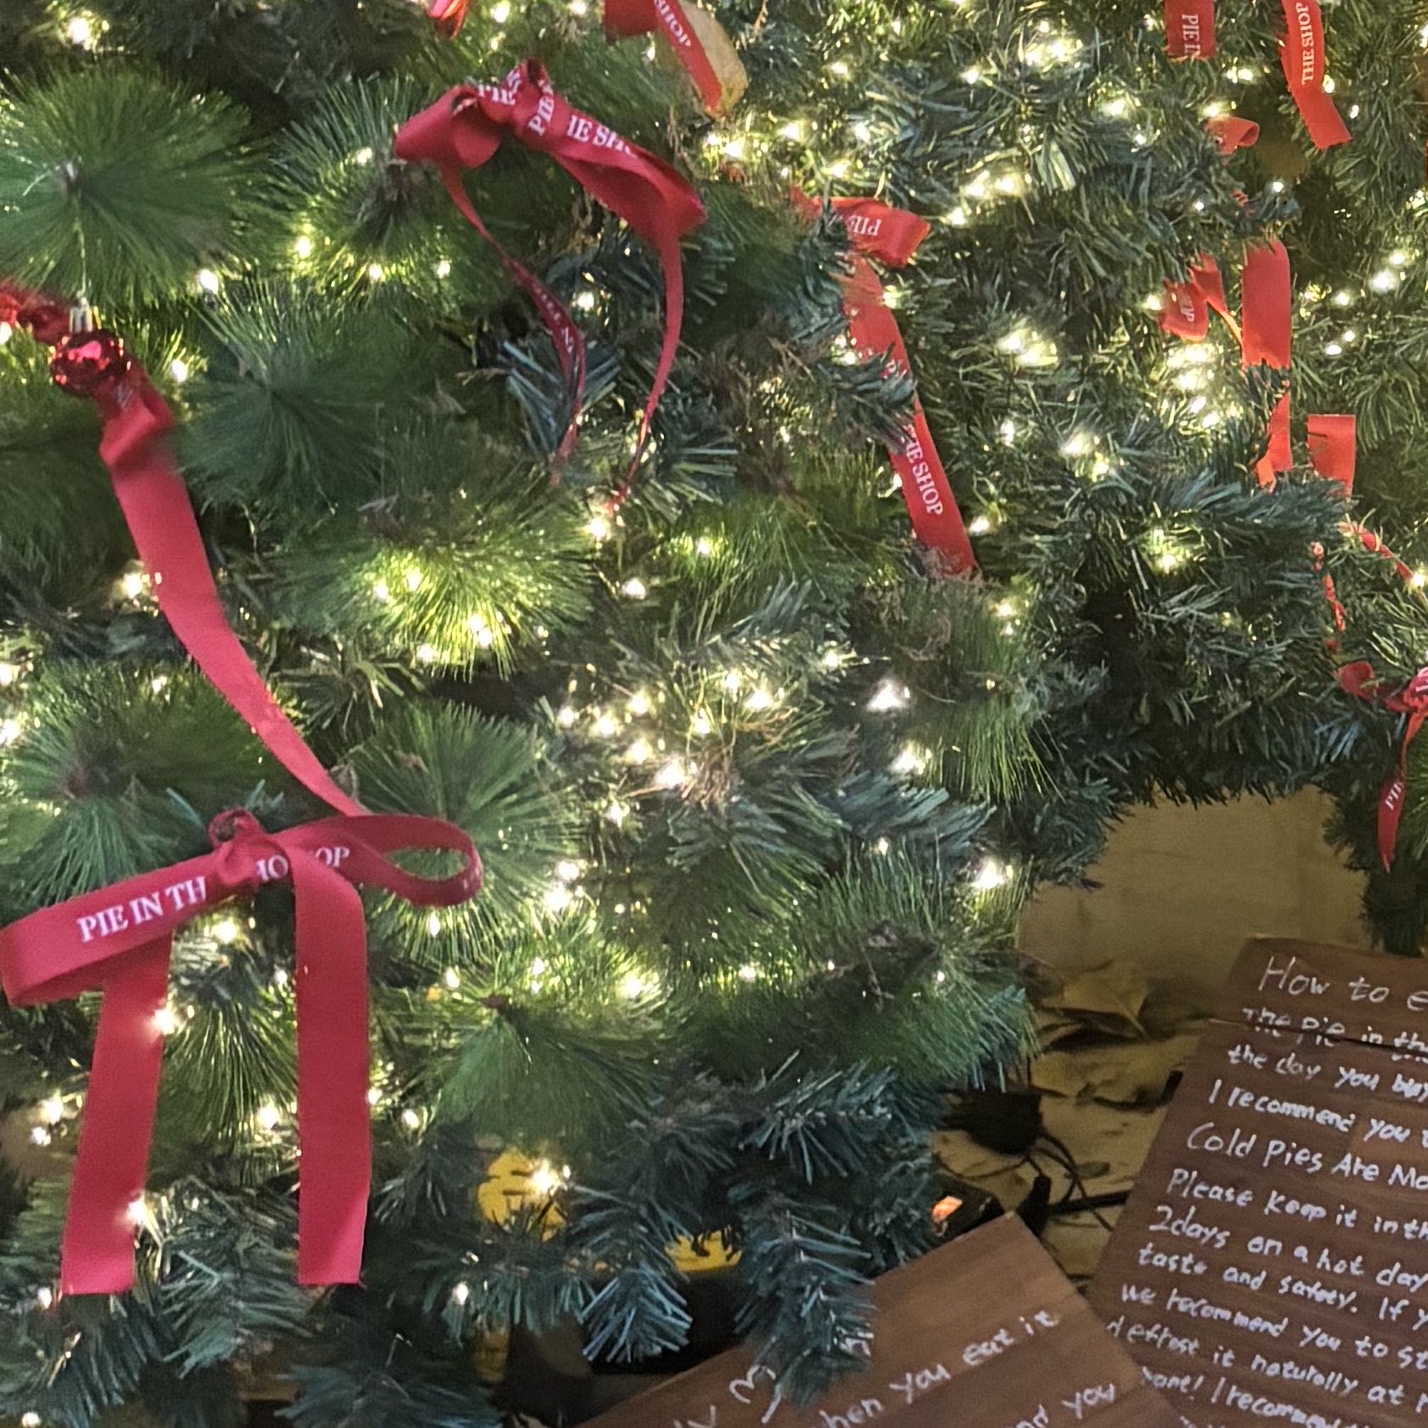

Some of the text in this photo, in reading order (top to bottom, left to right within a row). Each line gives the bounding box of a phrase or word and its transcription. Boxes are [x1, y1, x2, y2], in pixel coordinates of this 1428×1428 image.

[912, 462, 943, 516] SHOP
[77, 892, 163, 943] PIE IN
[1259, 957, 1330, 994] How
[1349, 977, 1390, 1004] to
[1228, 1046, 1379, 1090] the day you
[1187, 1122, 1254, 1156] Cold
[1263, 1140, 1324, 1173] Pies
[1368, 1118, 1409, 1143] you
[1336, 1204, 1356, 1228] it
[1248, 1237, 1283, 1260] on
[1316, 1248, 1365, 1276] hot
[1223, 1264, 1267, 1292] and
[890, 1366, 950, 1404] you
[962, 1326, 1012, 1366] eat
[1019, 1309, 1059, 1337] it
[1213, 1346, 1235, 1372] it
[1300, 1326, 1342, 1352] you
[1356, 1336, 1389, 1358] to
[1062, 1383, 1116, 1418] you
